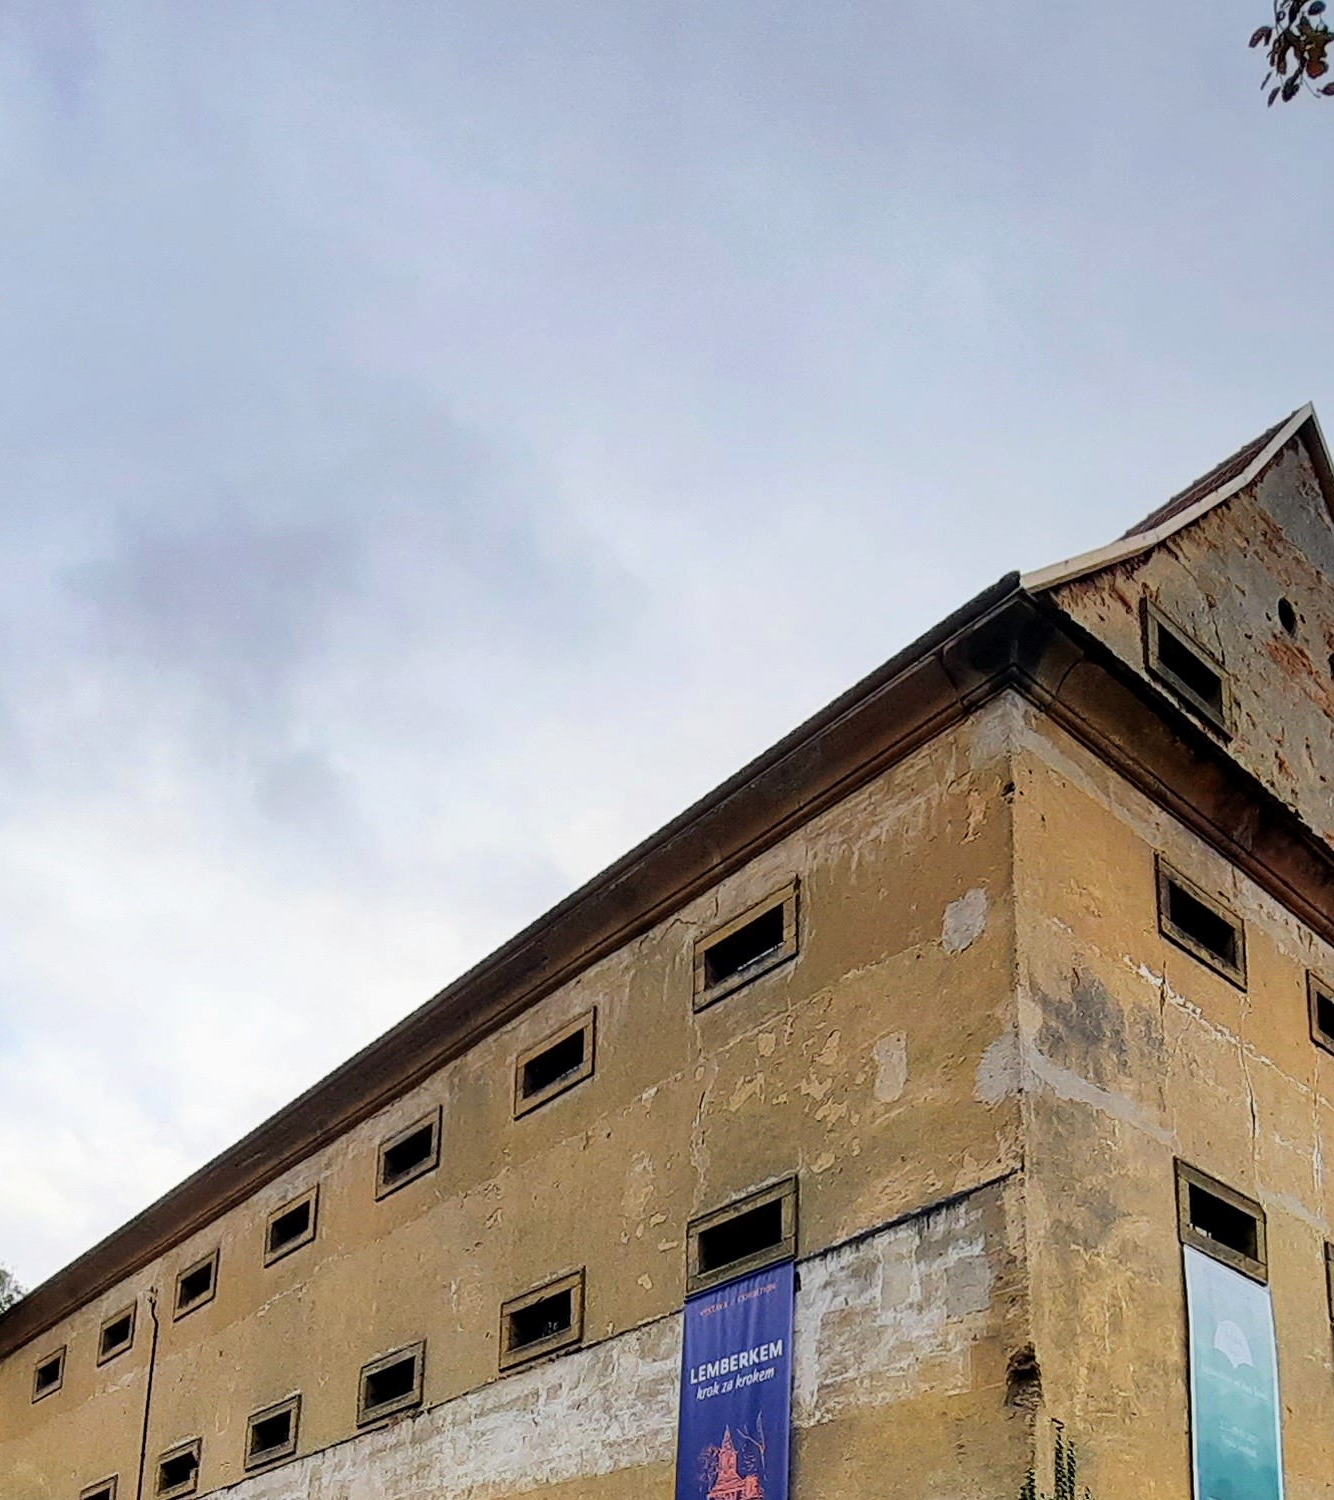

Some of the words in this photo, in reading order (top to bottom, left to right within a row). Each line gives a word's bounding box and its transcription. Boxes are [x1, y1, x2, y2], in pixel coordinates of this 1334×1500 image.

[690, 1339, 783, 1385] LEMBERKEM
[696, 1380, 720, 1401] krok
[721, 1376, 734, 1392] za
[735, 1367, 776, 1388] krokem
